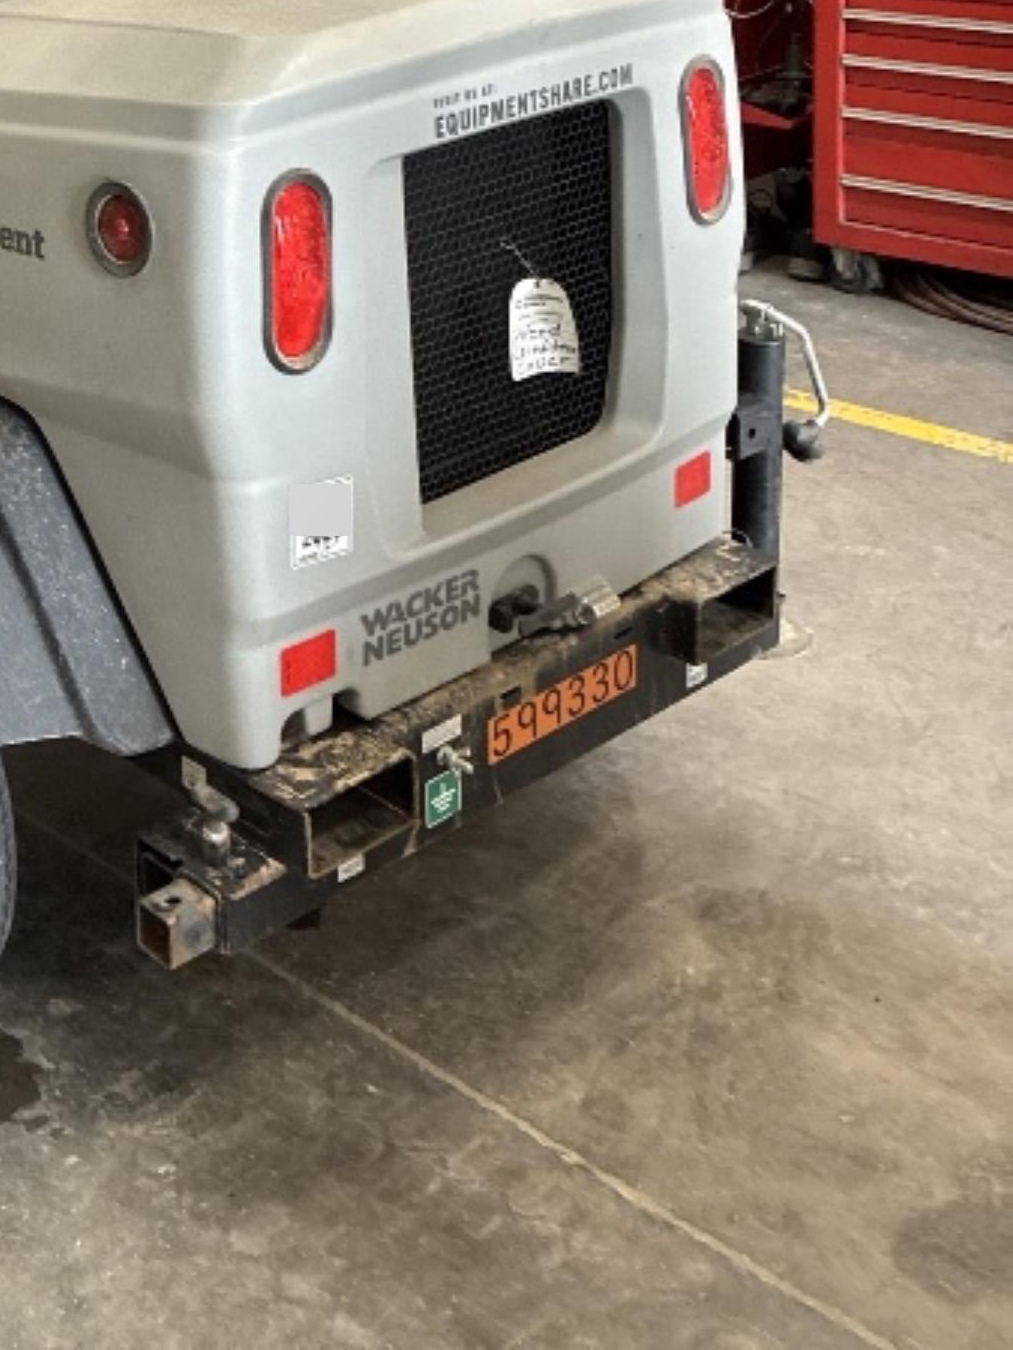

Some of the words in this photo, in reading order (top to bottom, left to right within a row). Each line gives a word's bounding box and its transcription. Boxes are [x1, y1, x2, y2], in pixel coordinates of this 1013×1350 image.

[433, 62, 633, 139] EQUIPMENTSHARE.COM
[359, 569, 480, 637] WACKER
[362, 592, 481, 667] NEUSON
[492, 650, 634, 757] 599330
